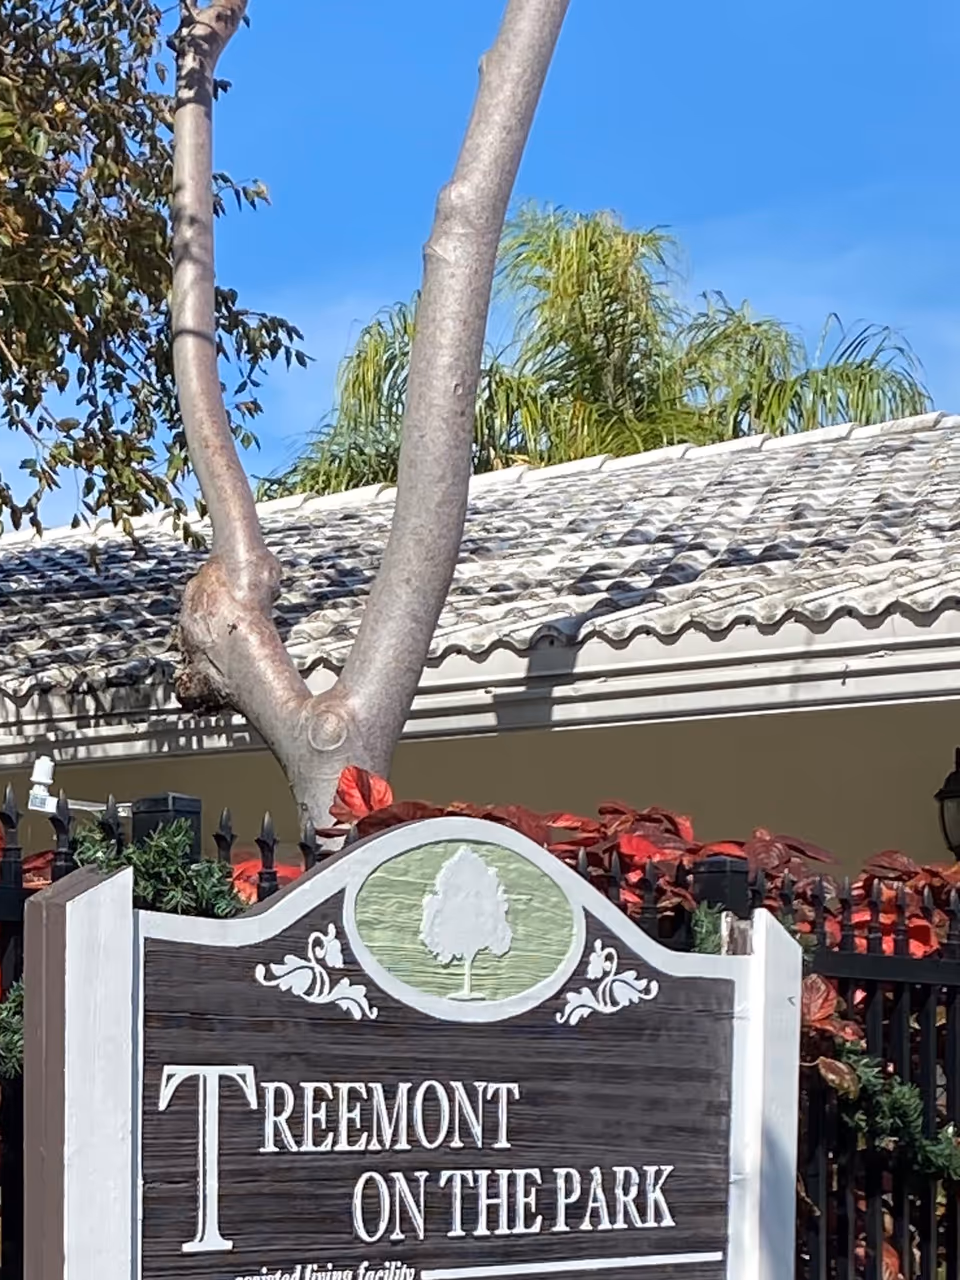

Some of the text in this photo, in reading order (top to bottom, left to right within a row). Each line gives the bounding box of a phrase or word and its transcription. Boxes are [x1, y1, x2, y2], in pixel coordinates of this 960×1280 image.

[158, 1065, 520, 1252] TREEMONT
[352, 1165, 676, 1243] ON THE PARK
